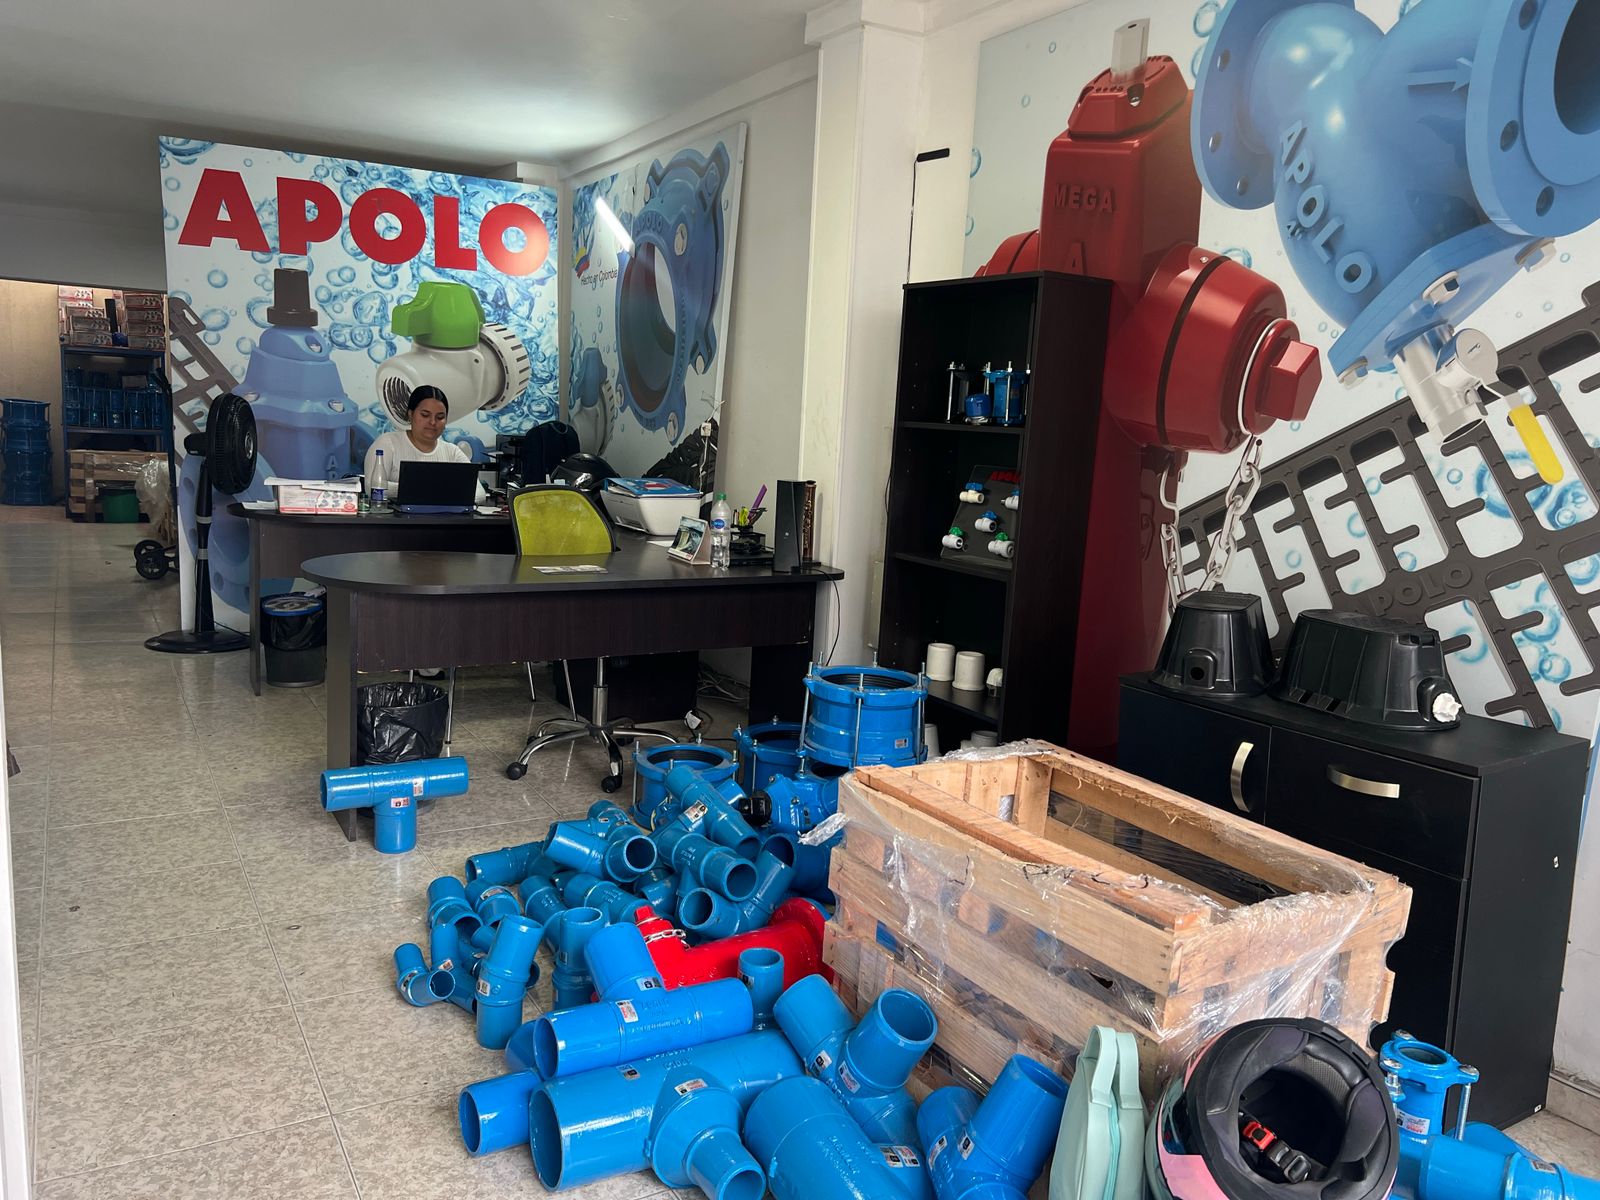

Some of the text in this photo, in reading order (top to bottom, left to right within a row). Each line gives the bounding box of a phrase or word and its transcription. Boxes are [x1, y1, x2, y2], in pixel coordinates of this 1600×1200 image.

[178, 168, 549, 276] APOLO
[634, 211, 664, 236] APOLO
[1053, 183, 1116, 213] MEGA
[1280, 120, 1374, 294] APOLO
